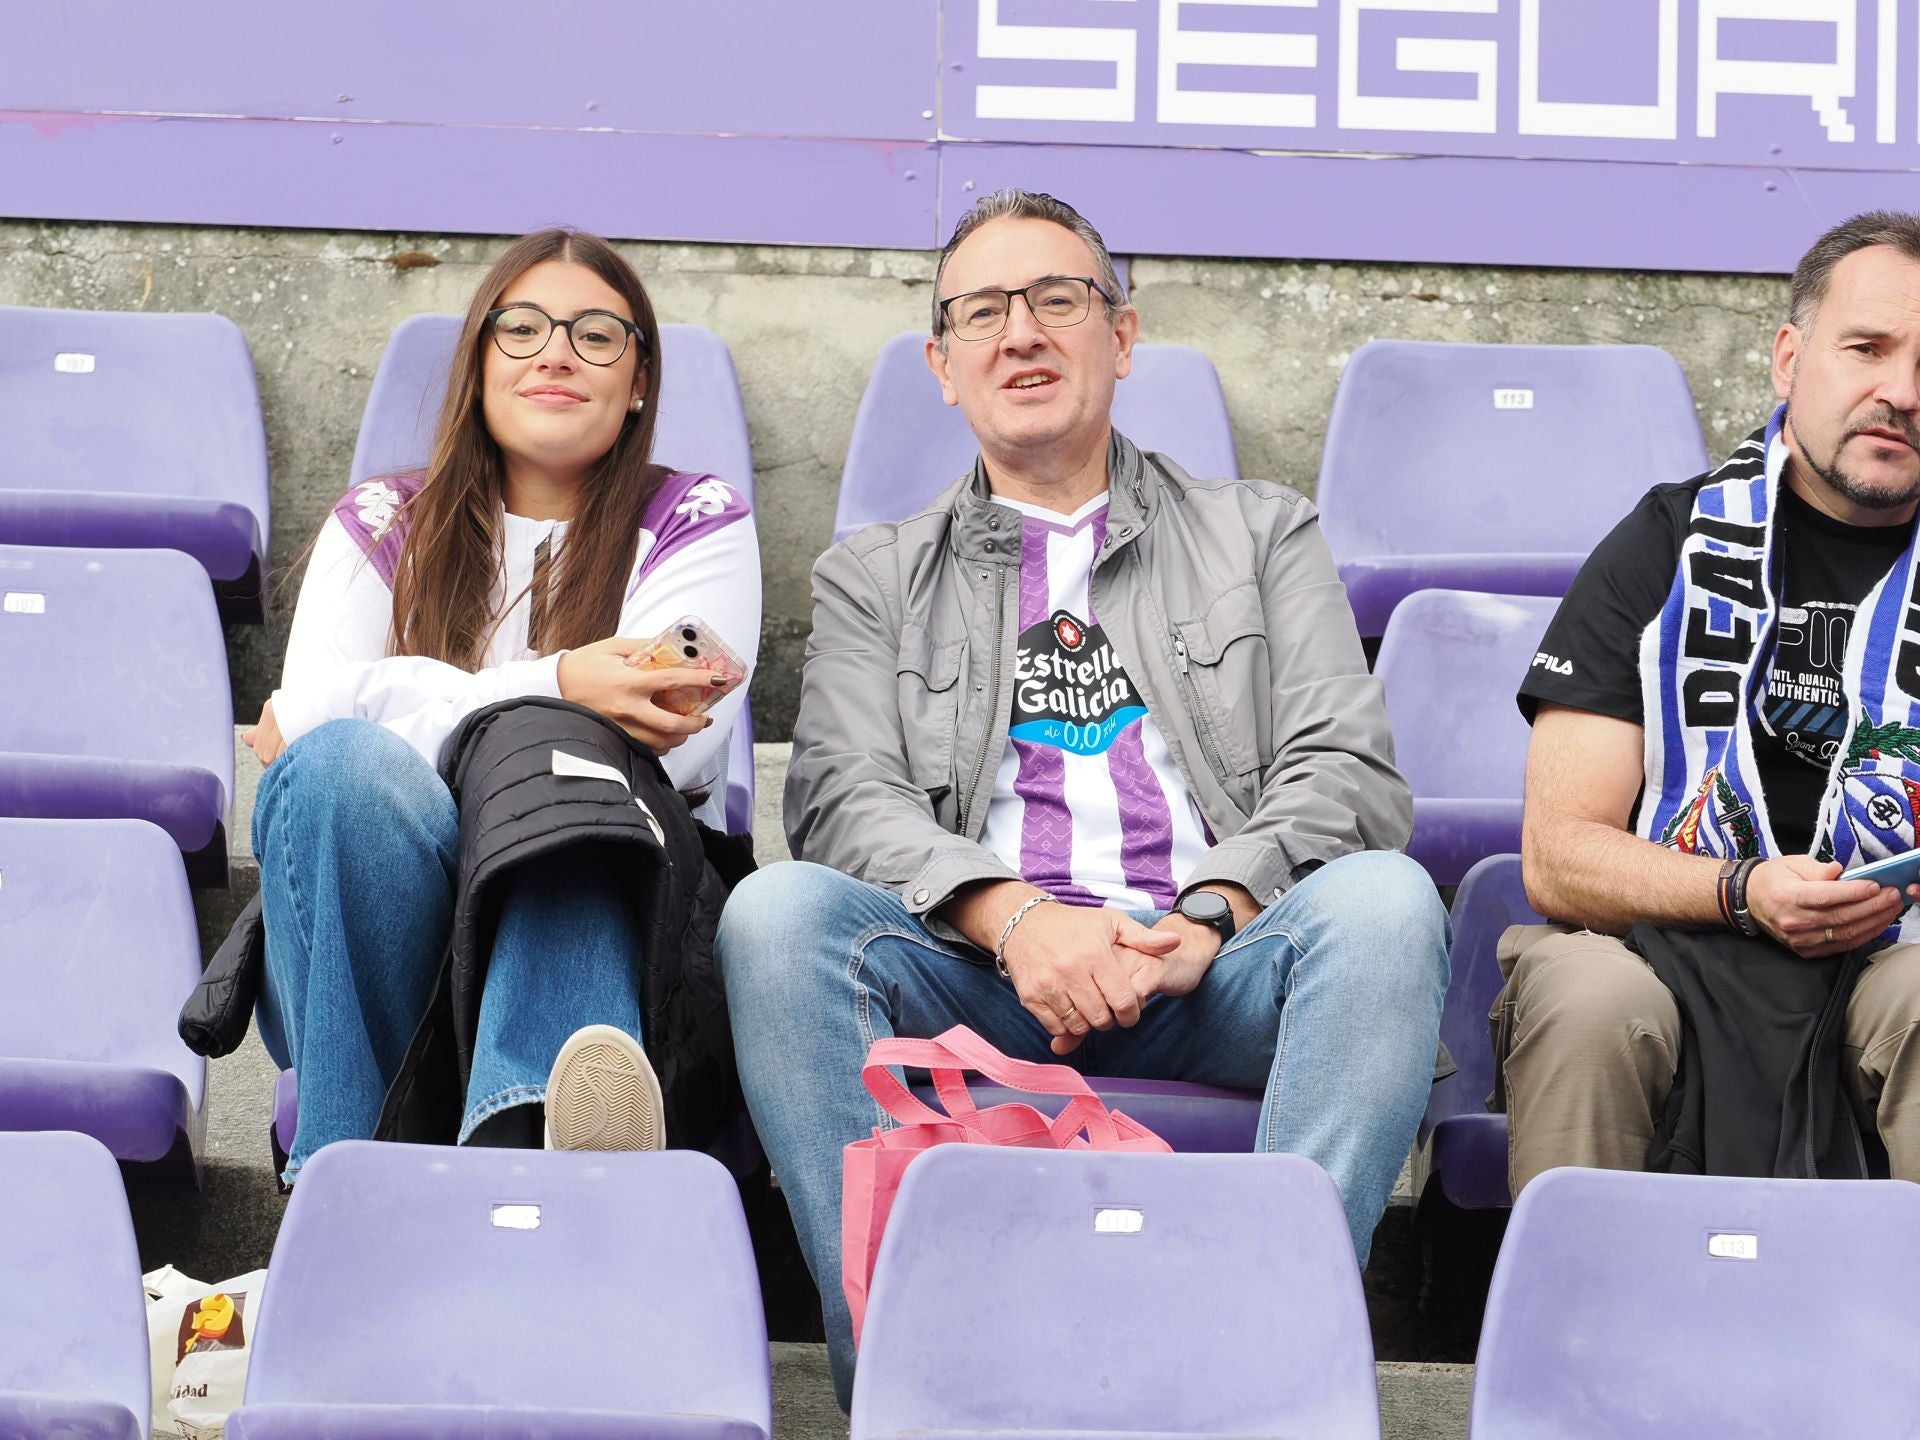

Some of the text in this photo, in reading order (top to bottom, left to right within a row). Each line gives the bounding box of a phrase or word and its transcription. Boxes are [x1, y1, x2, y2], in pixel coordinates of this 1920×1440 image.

[976, 0, 1920, 144] SEGURI
[1502, 392, 1526, 405] 113
[1532, 652, 1573, 676] FILA
[1768, 680, 1840, 707] AUTHENTIC
[1799, 672, 1840, 691] QUALITY
[1018, 677, 1130, 719] Galicia
[1064, 721, 1100, 749] 0,0
[1720, 1240, 1745, 1255] 113
